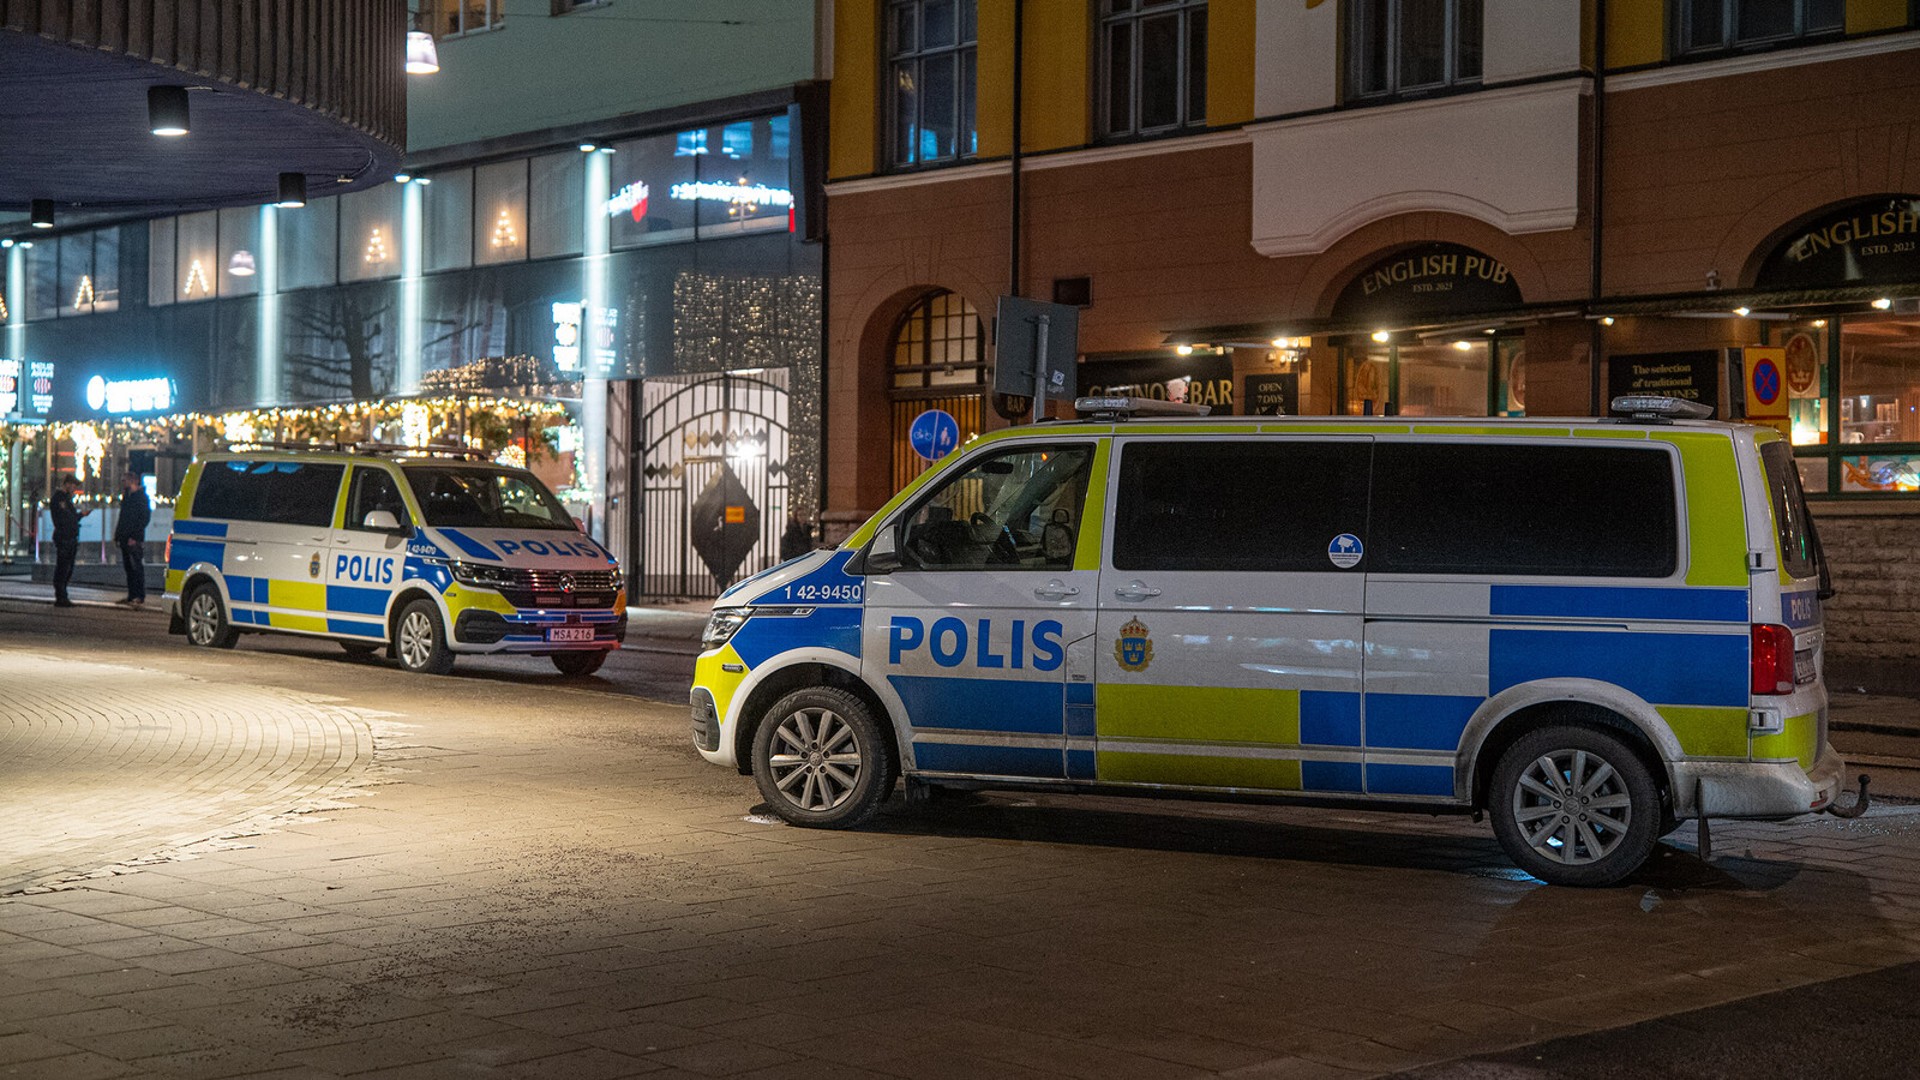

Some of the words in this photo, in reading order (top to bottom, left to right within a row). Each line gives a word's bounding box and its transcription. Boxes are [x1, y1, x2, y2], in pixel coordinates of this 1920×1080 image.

[1794, 211, 1918, 261] ENGLISH
[1861, 245, 1890, 256] ESTD.
[1892, 241, 1915, 252] 2023
[1361, 254, 1458, 295] ENGLISH
[1464, 255, 1511, 284] PUB
[1632, 364, 1650, 374] The
[1651, 363, 1691, 373] selection
[1258, 382, 1282, 393] OPEN
[1632, 377, 1644, 388] of
[1644, 376, 1693, 387] traditional
[1190, 379, 1234, 405] BAR
[1256, 394, 1263, 403] 7
[1007, 395, 1026, 413] BAR
[494, 540, 599, 558] POLIS
[335, 555, 394, 584] POLIS
[785, 586, 792, 599] 1
[797, 585, 861, 600] 42-9450
[1791, 597, 1812, 620] POLIS
[574, 629, 591, 639] 216
[888, 616, 1064, 672] POLIS
